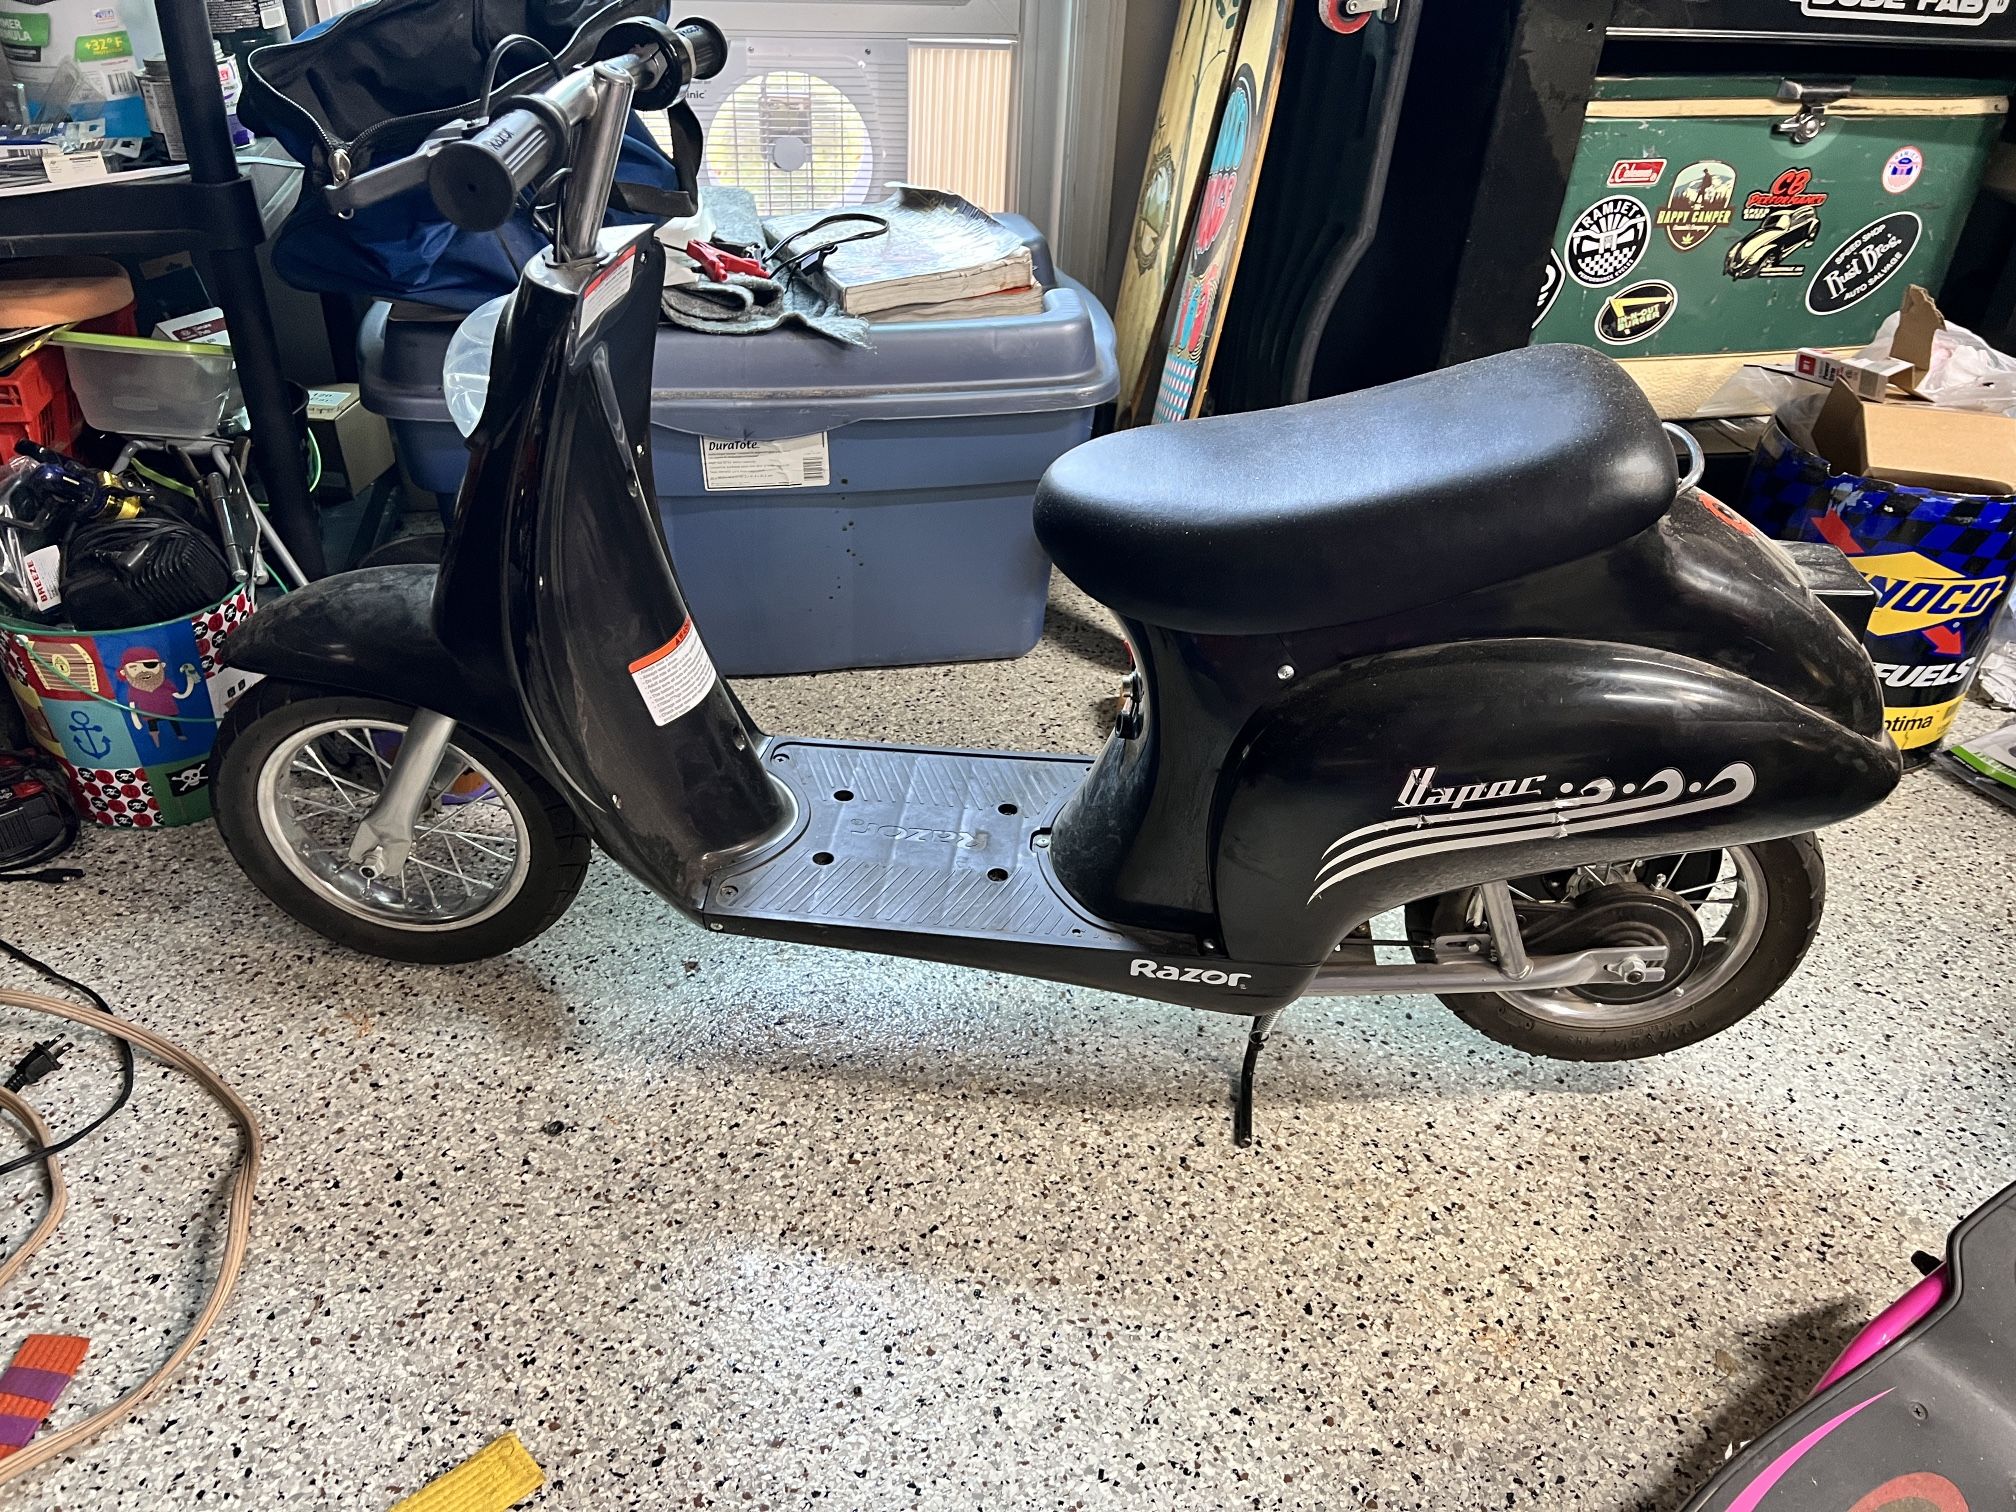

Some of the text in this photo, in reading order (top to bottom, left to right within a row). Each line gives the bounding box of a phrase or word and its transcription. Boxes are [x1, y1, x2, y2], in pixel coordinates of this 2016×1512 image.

[1773, 171, 1810, 195] CB
[1581, 200, 1640, 229] RAMJET
[1657, 210, 1732, 224] HAPPY CAMPER
[1835, 224, 1886, 265] SPEED SHOP
[1823, 258, 1862, 300] Rust
[1844, 251, 1903, 300] AUTO SALVAGE
[1617, 311, 1660, 332] BURGER
[709, 440, 757, 451] DuraTote
[26, 560, 48, 603] BREEZE
[1860, 572, 2001, 614] NOCO
[1873, 657, 1976, 687] FUELS
[1130, 958, 1252, 987] Razor
